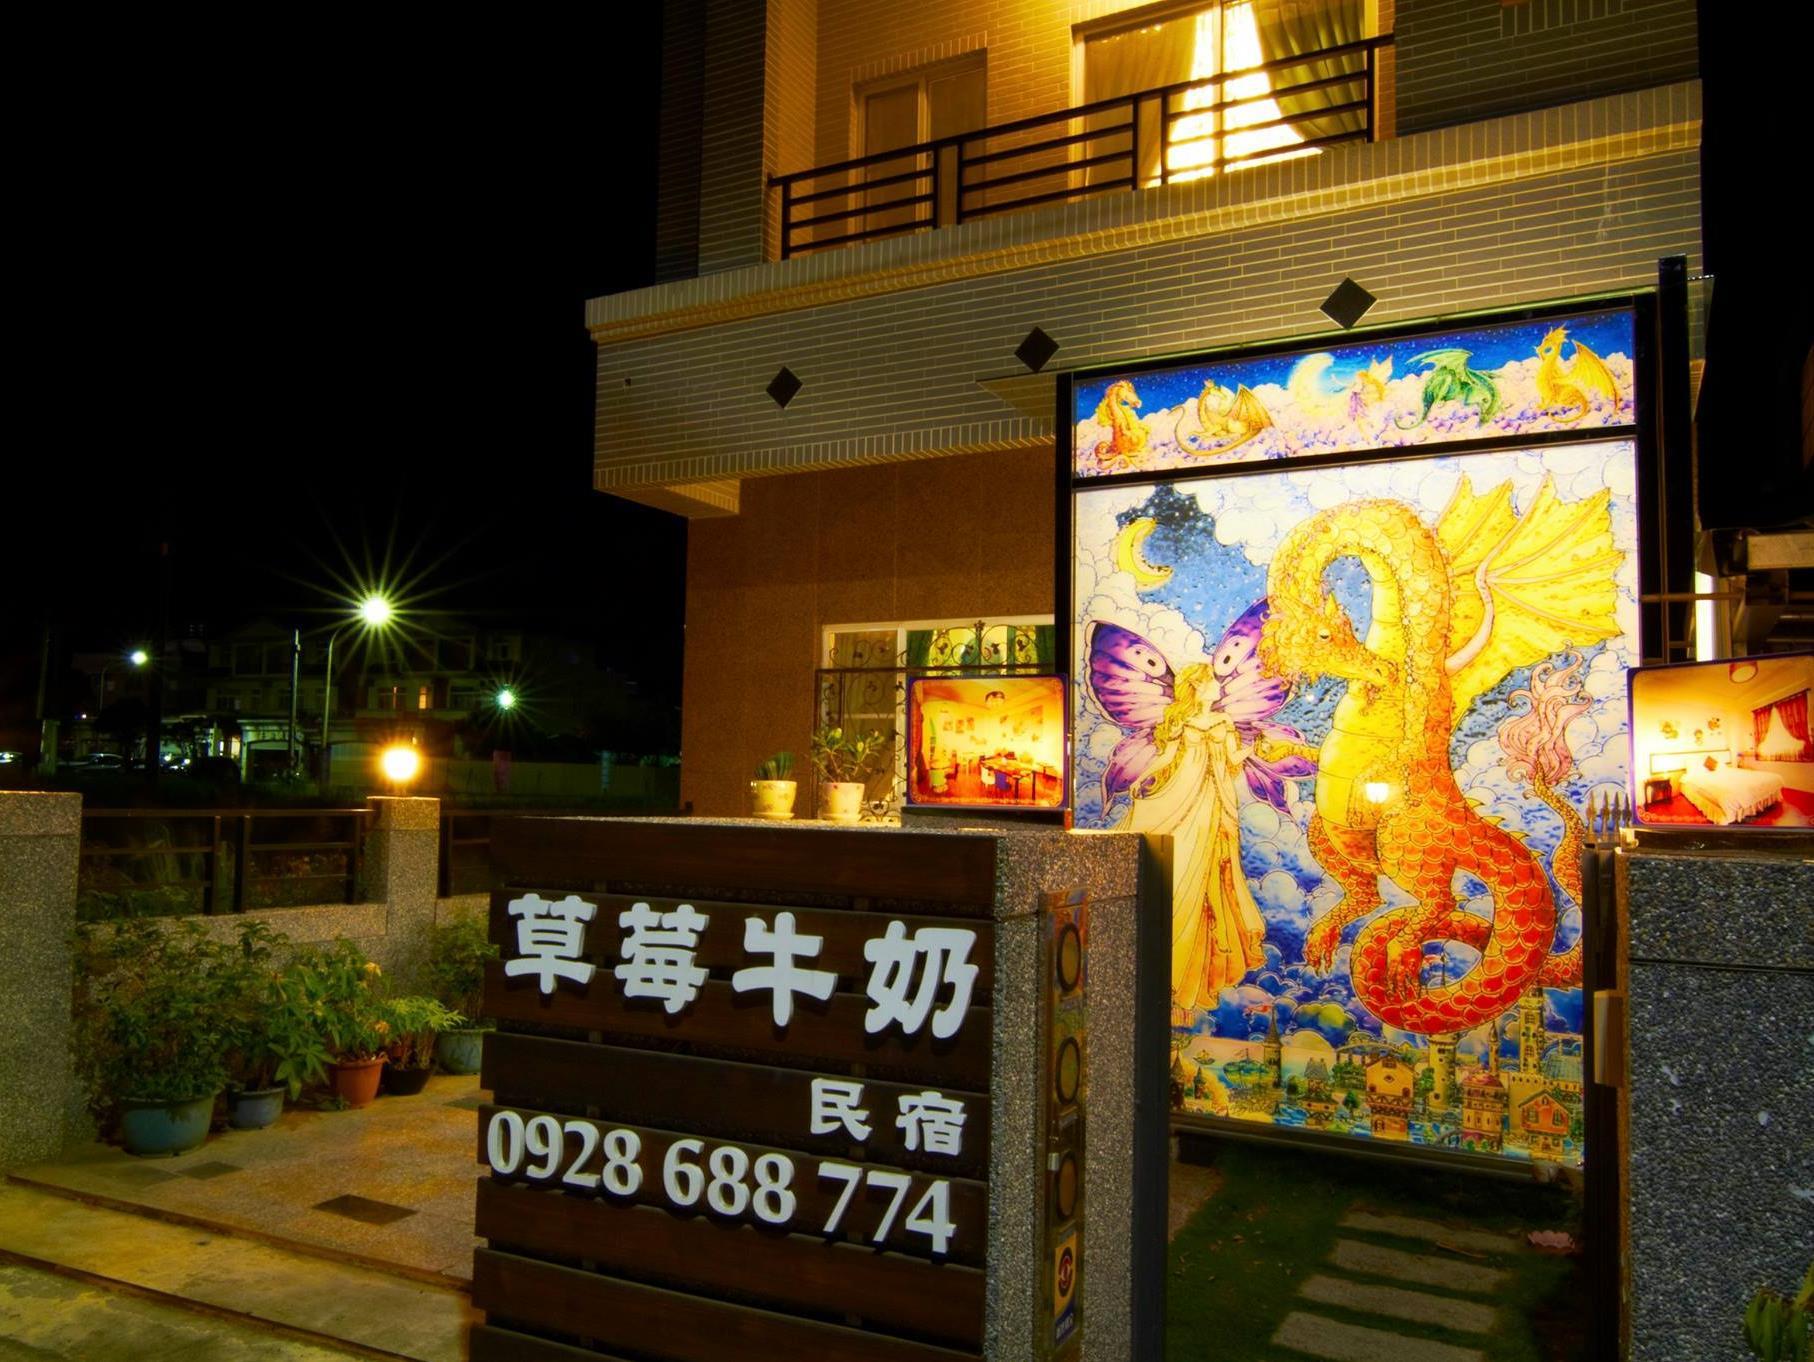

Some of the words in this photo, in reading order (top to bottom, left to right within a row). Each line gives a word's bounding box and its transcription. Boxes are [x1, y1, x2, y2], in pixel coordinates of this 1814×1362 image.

[504, 893, 979, 1039] 草莓牛奶
[487, 1110, 643, 1196] 0928
[663, 1138, 797, 1225] 688
[817, 1161, 957, 1254] 774
[810, 1078, 967, 1156] 民宿
